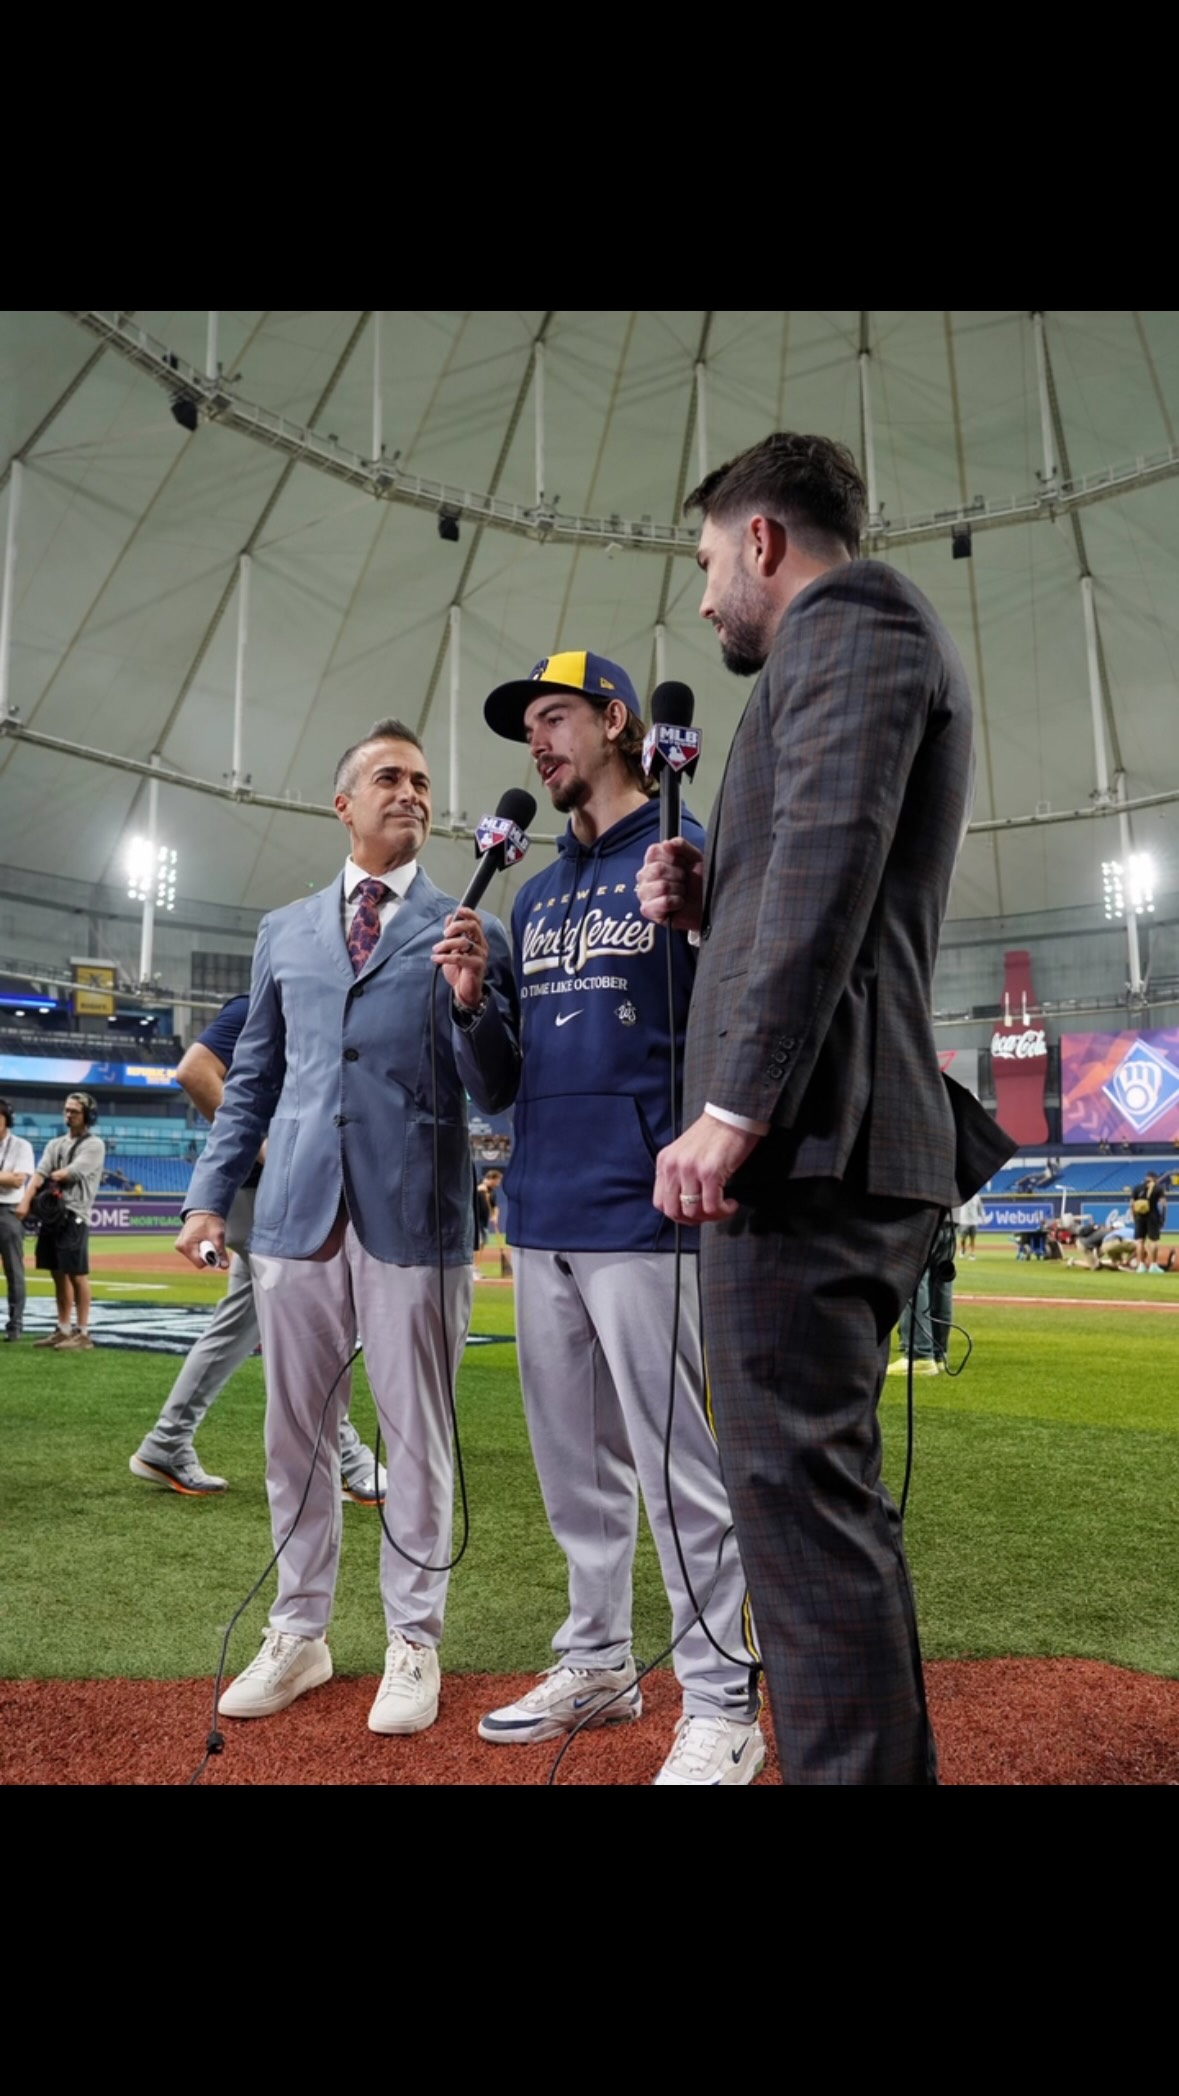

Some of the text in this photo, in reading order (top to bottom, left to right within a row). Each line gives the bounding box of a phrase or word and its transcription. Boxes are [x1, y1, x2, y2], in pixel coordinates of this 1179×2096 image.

[660, 726, 698, 743] MLB
[480, 816, 511, 833] MLB
[523, 908, 656, 973] World Series
[520, 975, 628, 999] O TIME LIKE OCTOBER
[991, 1030, 1048, 1059] Coca-Cola
[90, 1208, 183, 1228] OME MORTGAG
[995, 1210, 1044, 1225] Webull
